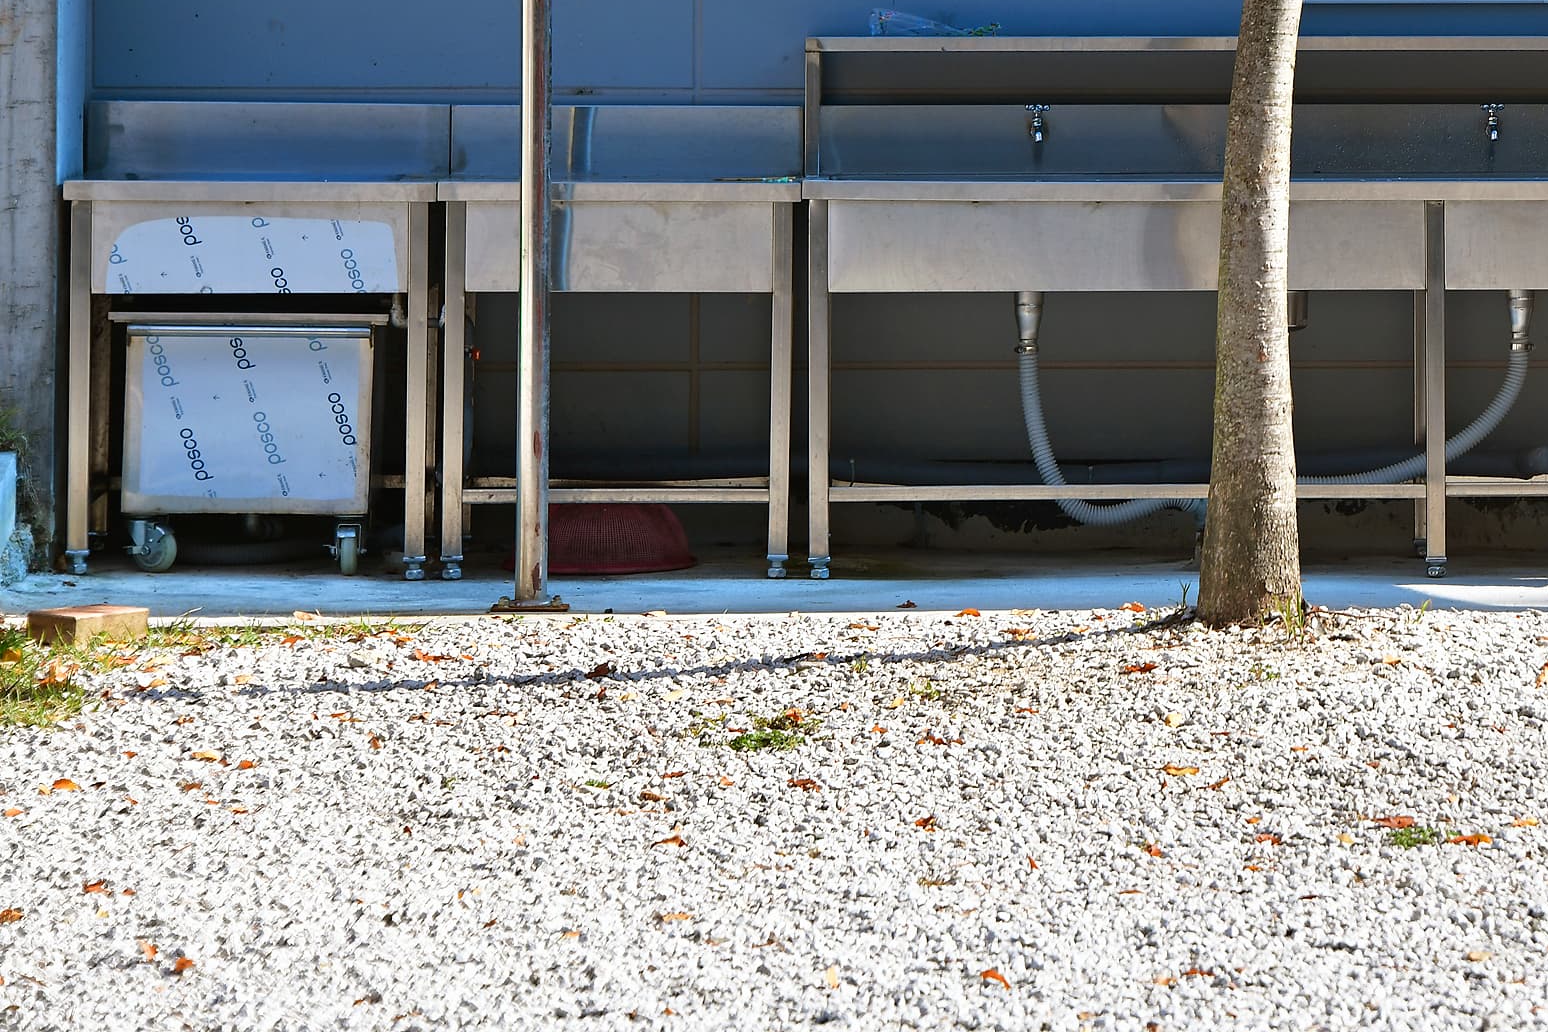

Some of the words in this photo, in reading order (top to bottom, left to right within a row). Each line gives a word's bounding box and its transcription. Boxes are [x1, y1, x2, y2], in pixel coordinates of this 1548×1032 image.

[176, 217, 202, 246] pos
[271, 268, 291, 294] sco
[341, 249, 367, 294] osco
[230, 338, 256, 370] pos
[254, 412, 286, 465] posco
[328, 393, 357, 446] posco
[180, 428, 214, 481] posco
